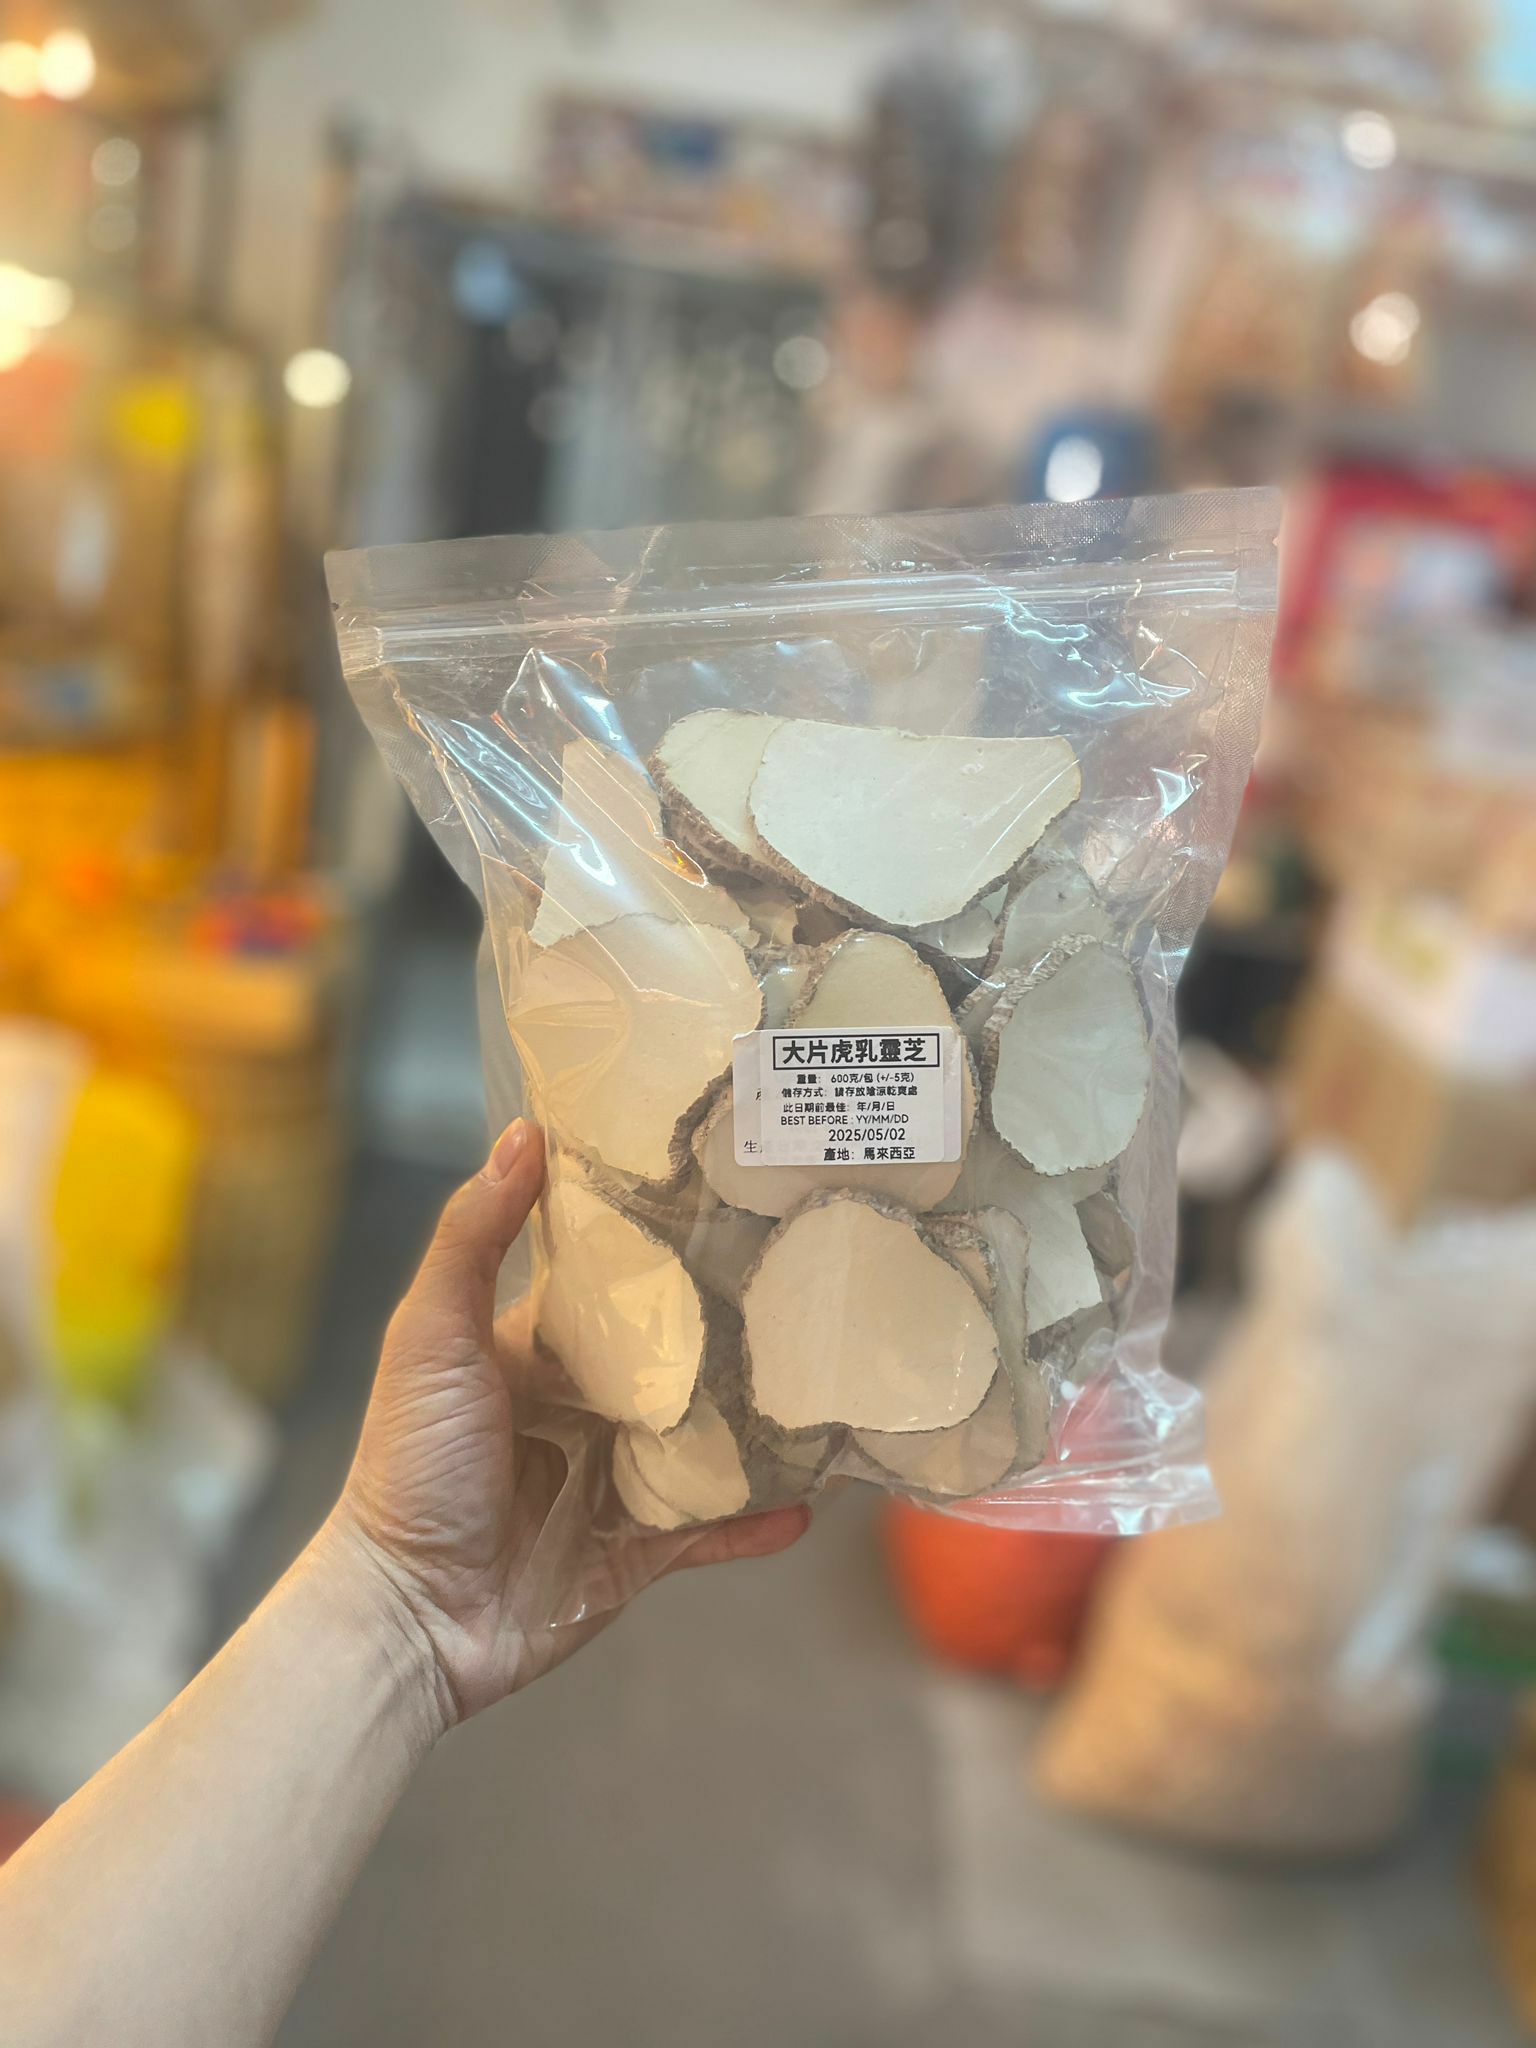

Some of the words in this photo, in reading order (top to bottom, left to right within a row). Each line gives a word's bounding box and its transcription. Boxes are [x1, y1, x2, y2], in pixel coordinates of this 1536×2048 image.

[782, 1038, 926, 1064] 大片虎乳靈芝
[857, 1101, 895, 1111] 年/月/日
[781, 1116, 805, 1125] BEST
[808, 1116, 849, 1125] BEFORE
[856, 1115, 909, 1124] YY/MM/DD
[828, 1128, 906, 1142] 2025/05/02
[863, 1147, 915, 1160] 馬來西亞
